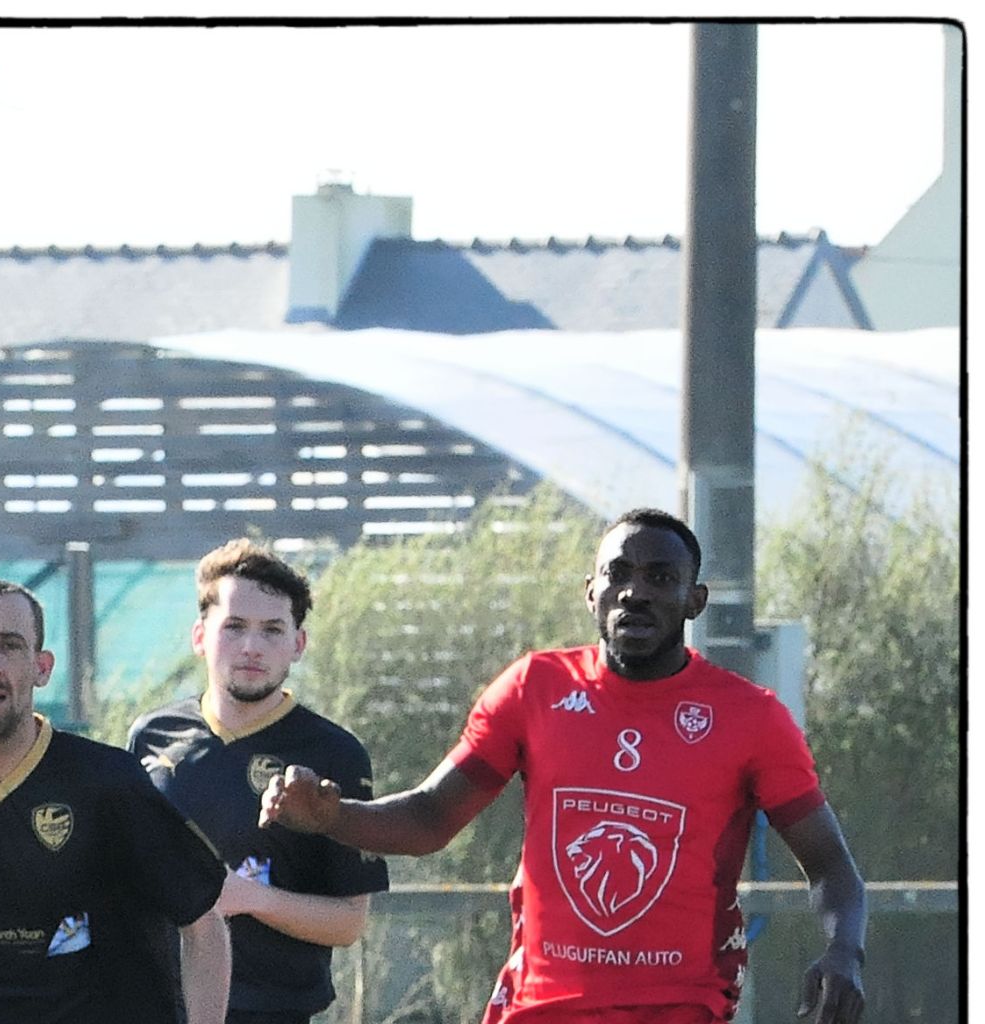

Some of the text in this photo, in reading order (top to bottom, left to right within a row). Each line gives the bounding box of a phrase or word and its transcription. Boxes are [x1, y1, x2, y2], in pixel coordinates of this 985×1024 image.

[613, 728, 642, 772] 8
[562, 799, 673, 824] PEUGEOT
[542, 941, 683, 966] PLUGUFFAN AUTO
